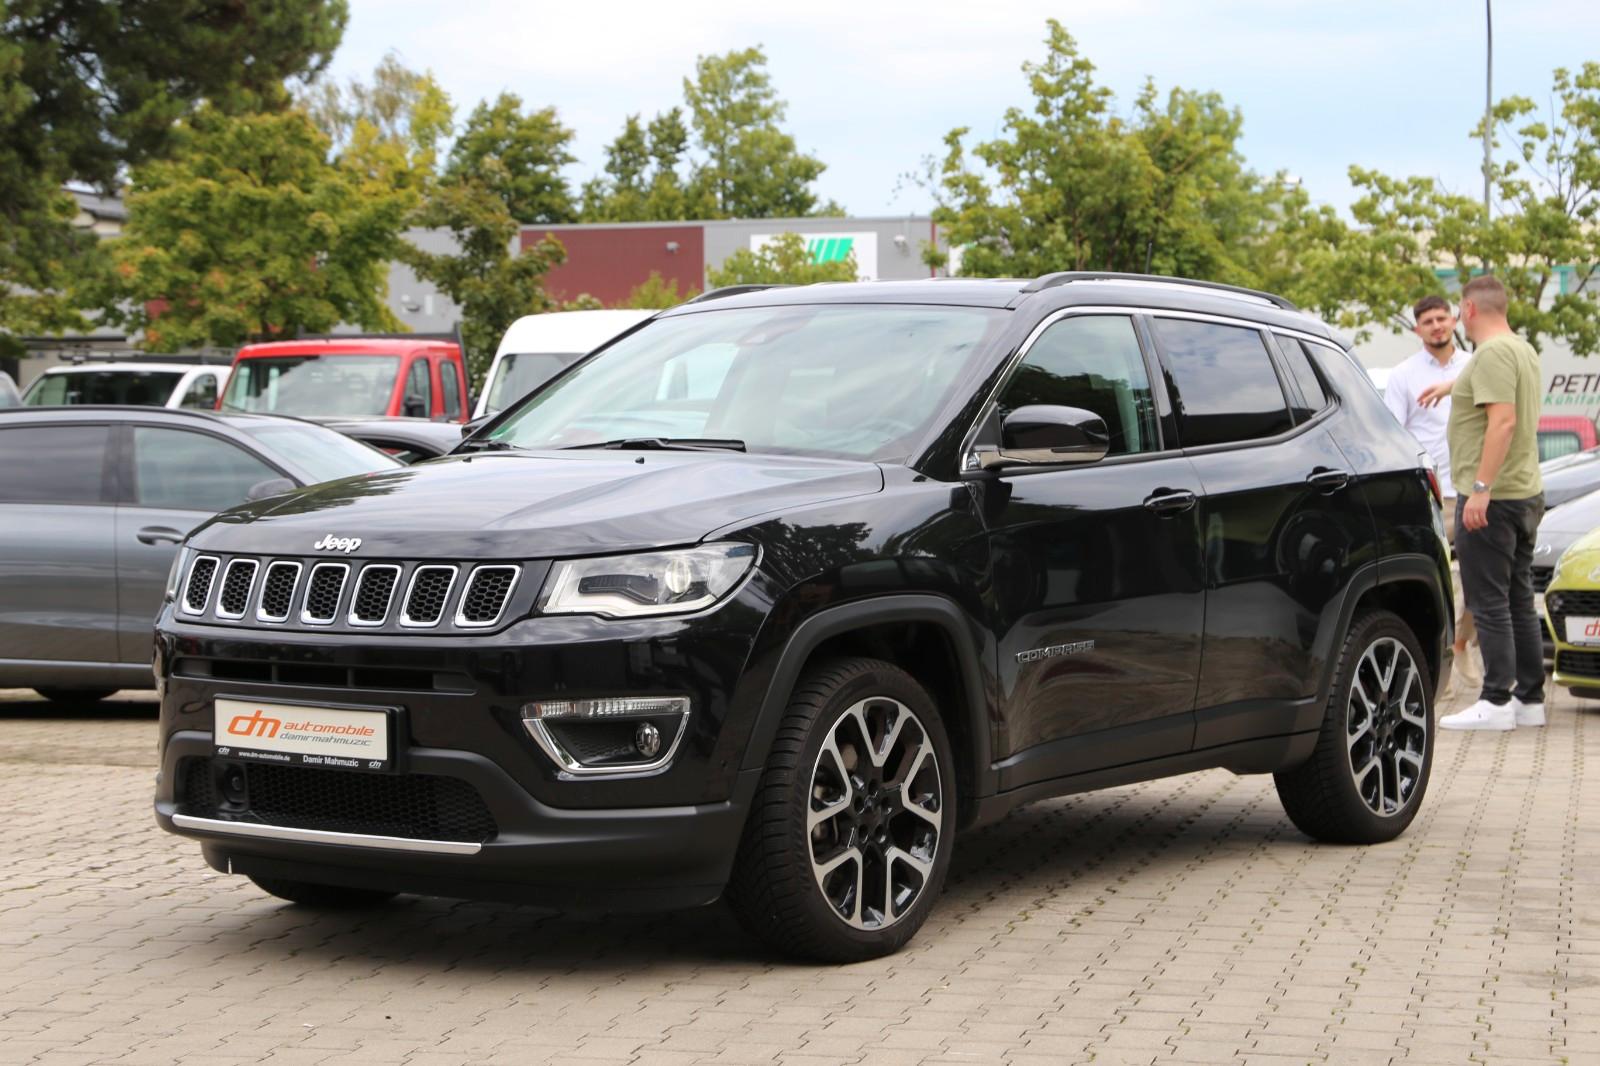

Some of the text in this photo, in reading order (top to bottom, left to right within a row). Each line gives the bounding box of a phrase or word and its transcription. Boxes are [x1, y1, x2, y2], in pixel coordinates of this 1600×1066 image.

[314, 534, 362, 554] Jeep
[1017, 640, 1095, 664] COMPASS
[227, 709, 375, 738] dm automobile
[302, 754, 323, 765] Damir
[324, 756, 360, 768] Mahmuzic
